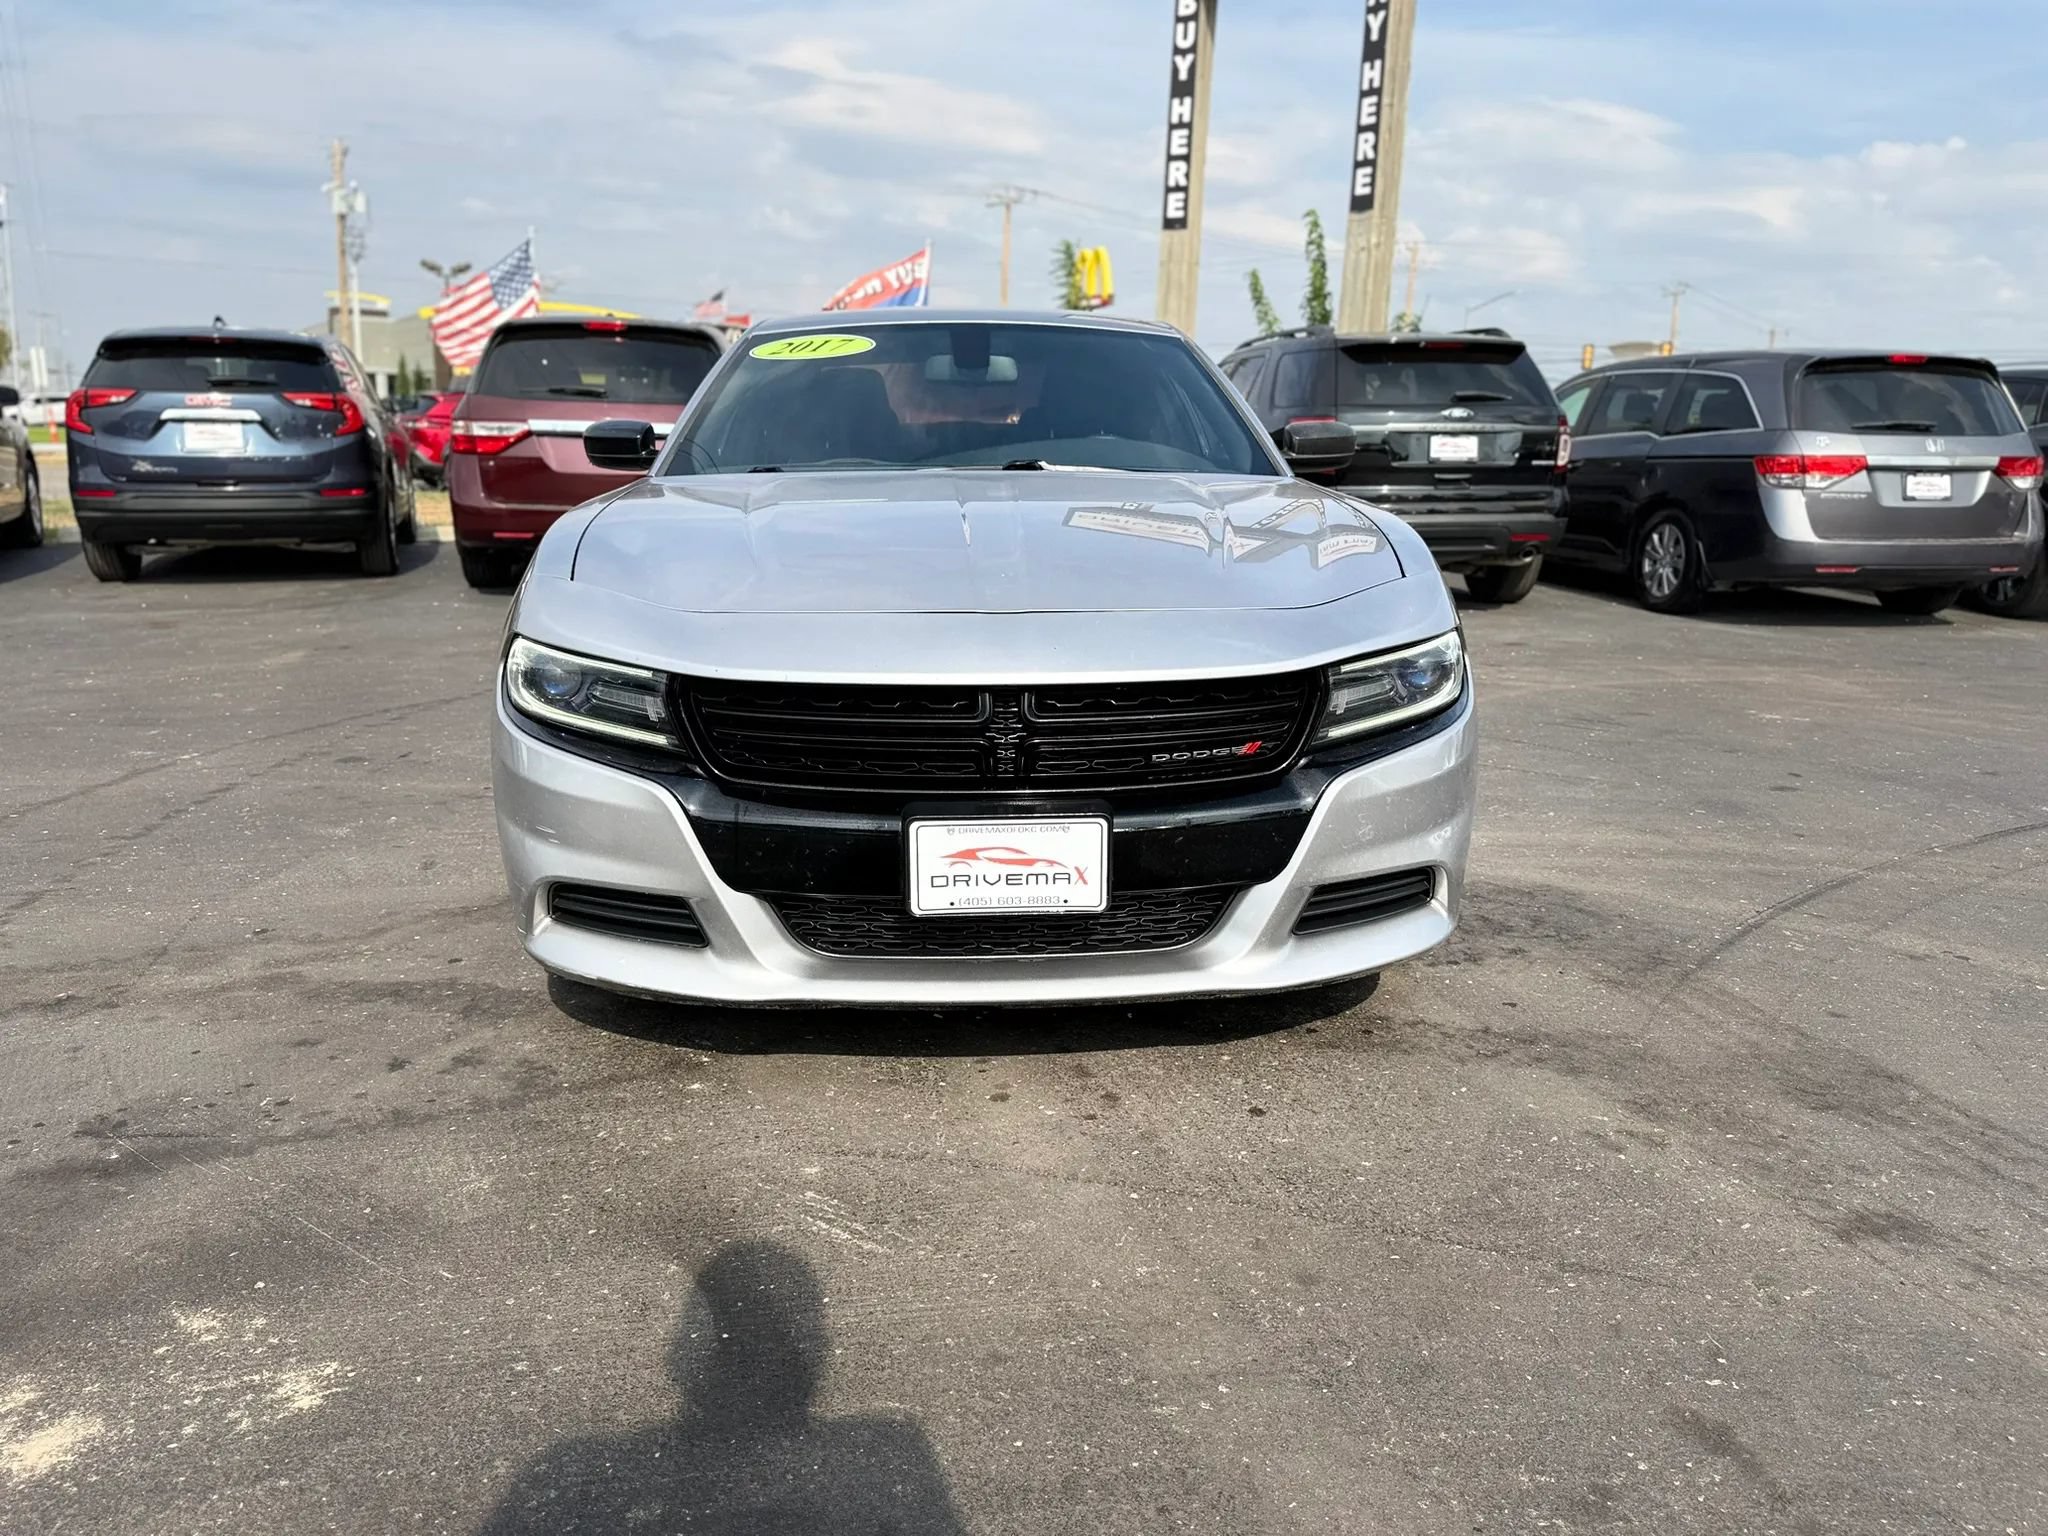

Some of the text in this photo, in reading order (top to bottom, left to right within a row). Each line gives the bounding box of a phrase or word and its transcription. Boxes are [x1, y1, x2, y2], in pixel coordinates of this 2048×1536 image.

[1353, 0, 1387, 196] Y HERE
[1165, 0, 1198, 219] BUY HERE
[767, 339, 856, 355] 2017
[1151, 746, 1245, 763] DODGE
[930, 866, 1088, 888] DRIVEMAX
[958, 895, 1061, 907] (405) 603-8883
